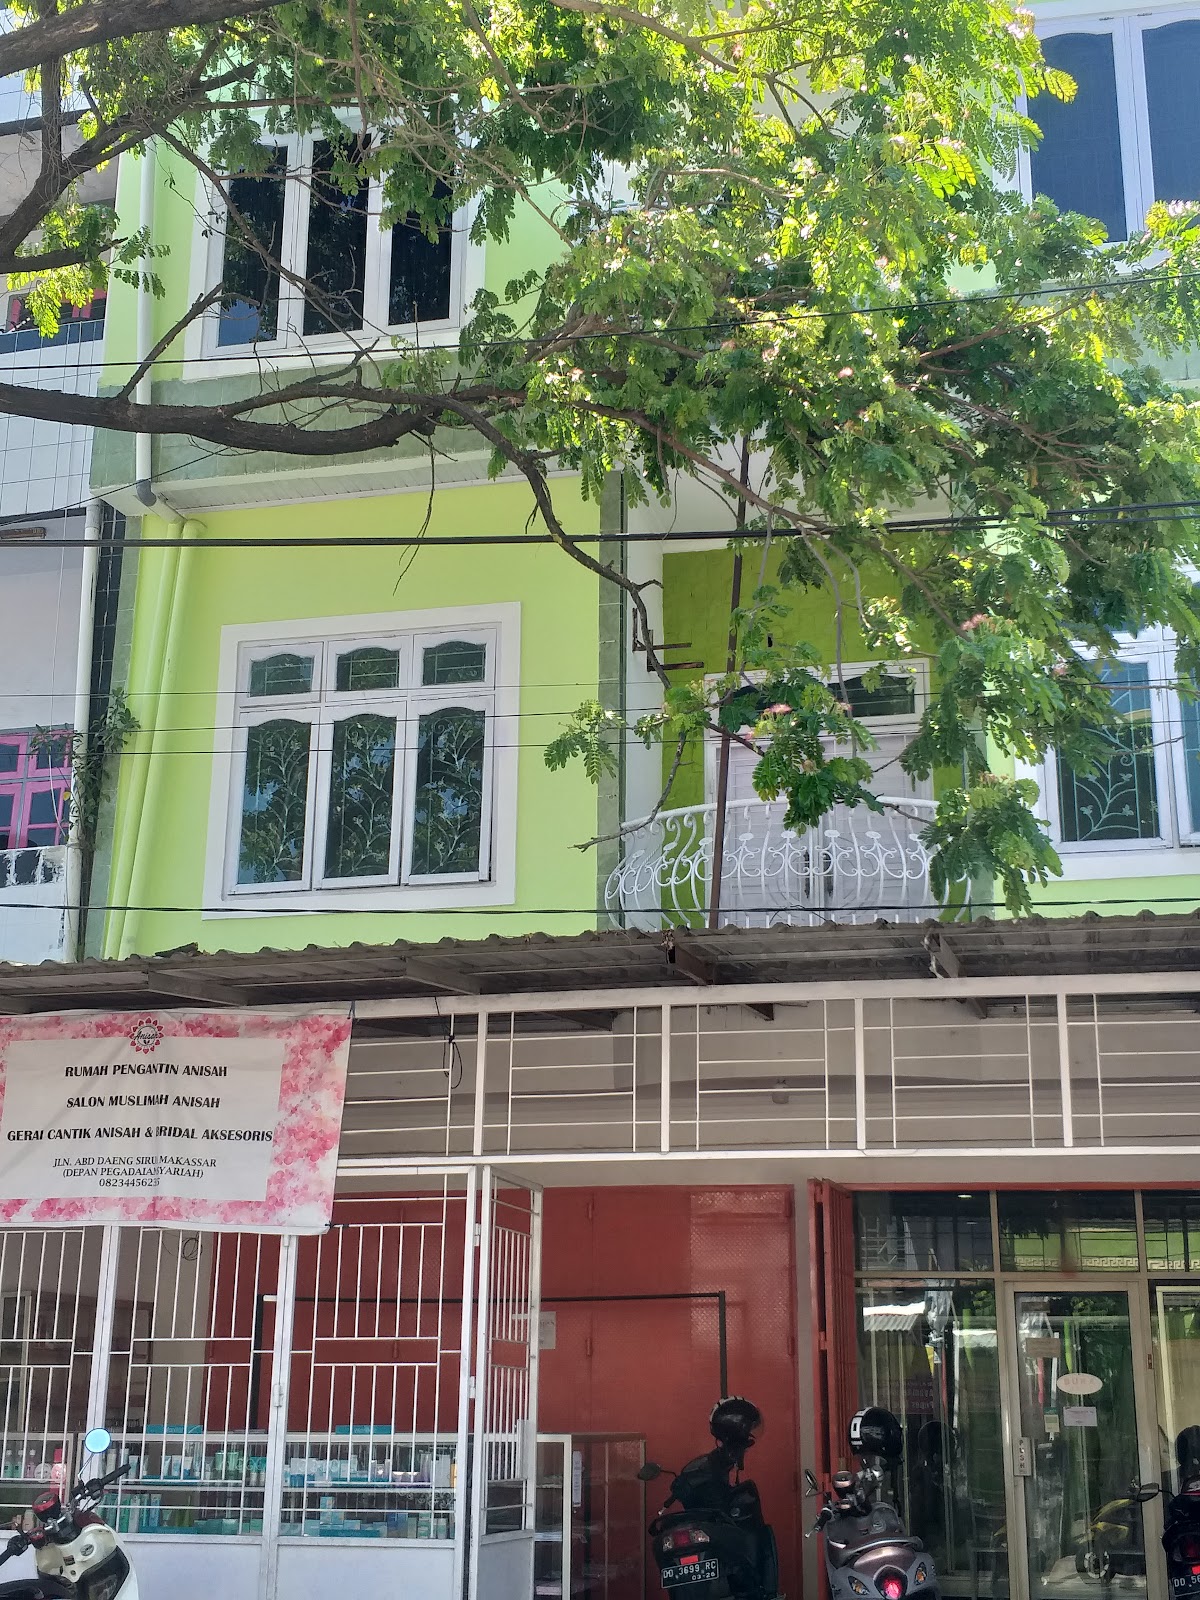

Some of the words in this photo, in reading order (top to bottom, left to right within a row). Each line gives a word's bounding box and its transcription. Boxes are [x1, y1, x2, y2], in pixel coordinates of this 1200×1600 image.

[64, 1065, 109, 1078] RUMAH
[112, 1062, 179, 1077] PENGANTIN
[182, 1065, 228, 1077] ANISAH
[66, 1096, 105, 1109] SALON
[108, 1094, 169, 1108] MUSLIMAH
[172, 1095, 220, 1108] ANISAH
[7, 1130, 44, 1142] GERAI
[47, 1128, 92, 1140] CANTIK
[94, 1127, 141, 1139] ANISAH
[144, 1126, 153, 1138] &
[155, 1125, 198, 1140] BRIDAL
[201, 1128, 273, 1142] AKSESORIS
[53, 1158, 72, 1168] JLN.
[74, 1157, 95, 1166] ABD
[97, 1156, 133, 1166] DAENG
[135, 1156, 158, 1165] SIRU
[159, 1155, 217, 1167] MAKASSAR
[63, 1167, 99, 1178] (DEPAN
[705, 1561, 717, 1571] RC
